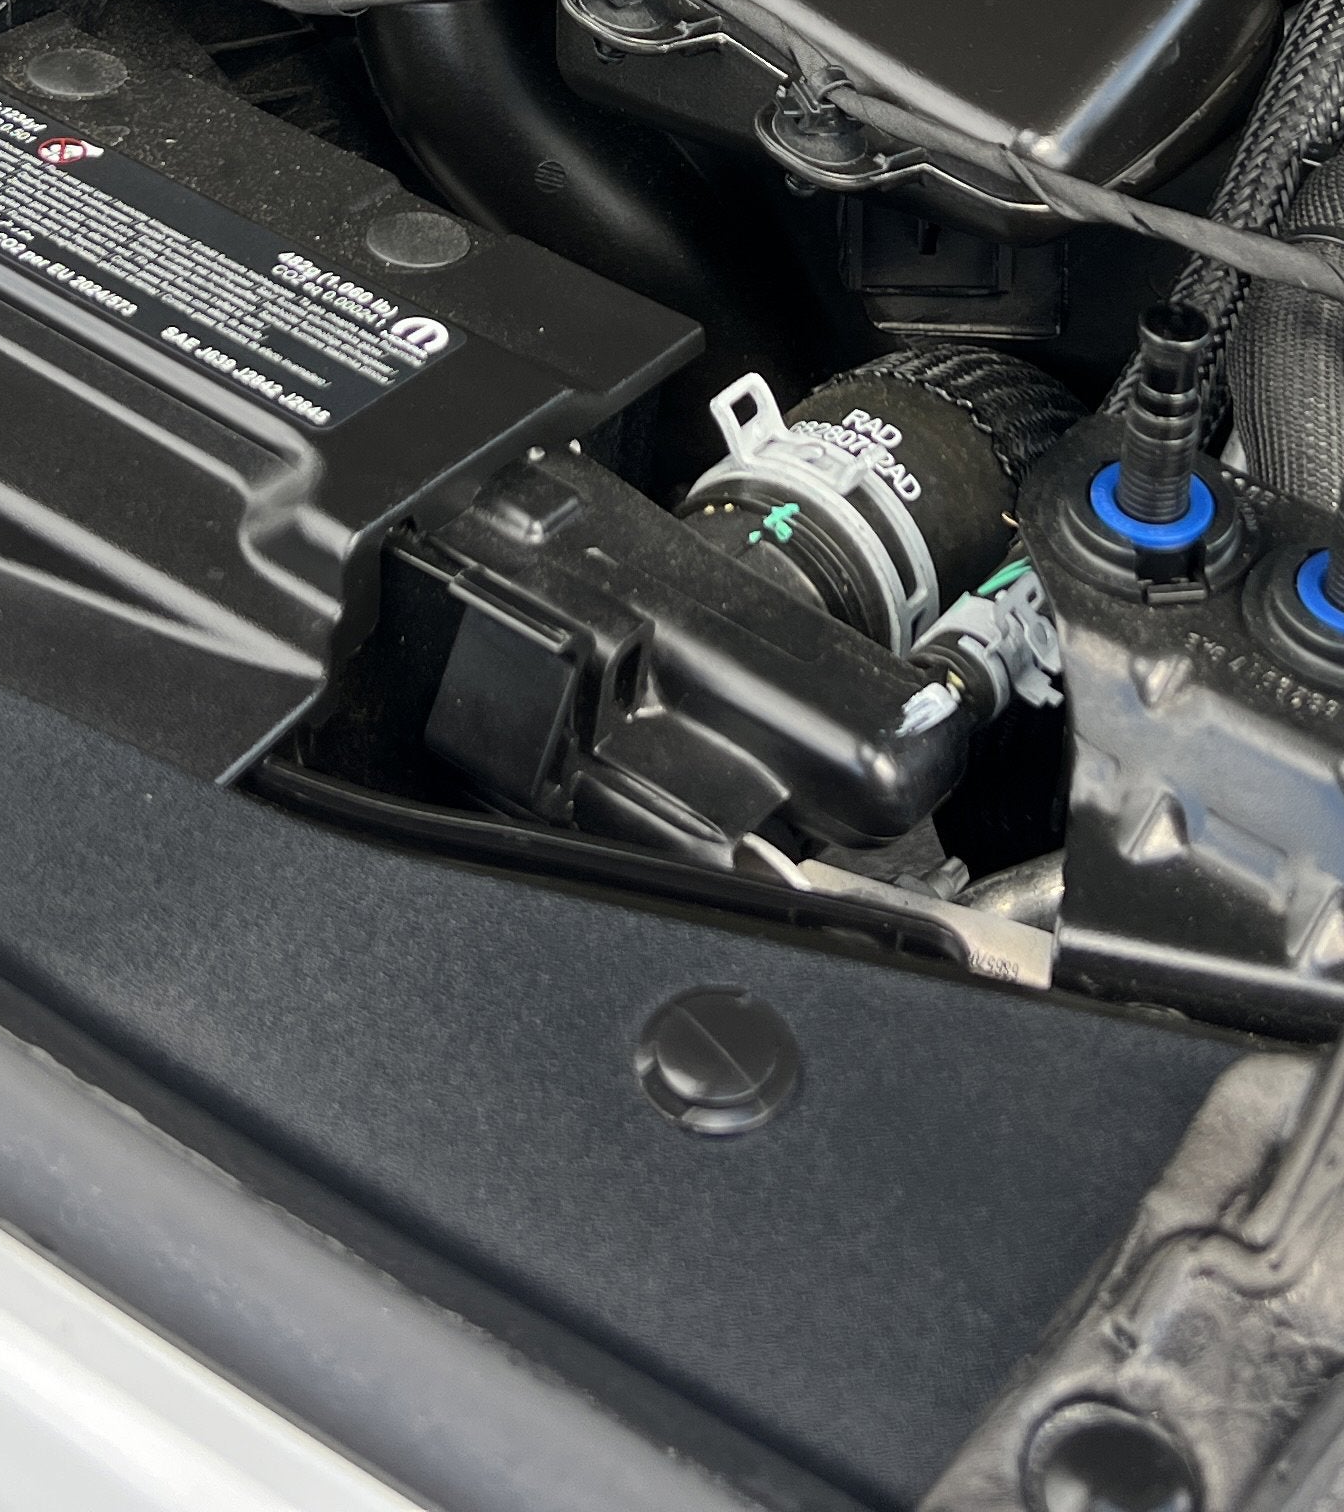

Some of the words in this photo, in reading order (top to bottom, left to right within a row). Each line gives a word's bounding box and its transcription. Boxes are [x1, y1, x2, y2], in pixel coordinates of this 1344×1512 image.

[0, 124, 37, 143] 0.501
[18, 251, 50, 267] per
[47, 263, 75, 280] EU
[69, 276, 137, 316] 2024/573
[272, 265, 309, 285] CO2
[161, 327, 200, 351] SAE
[195, 347, 236, 372] J639
[232, 368, 282, 398] J2842
[278, 393, 330, 424] J2845
[842, 408, 903, 449] RAD
[789, 420, 922, 501] 6828072AD
